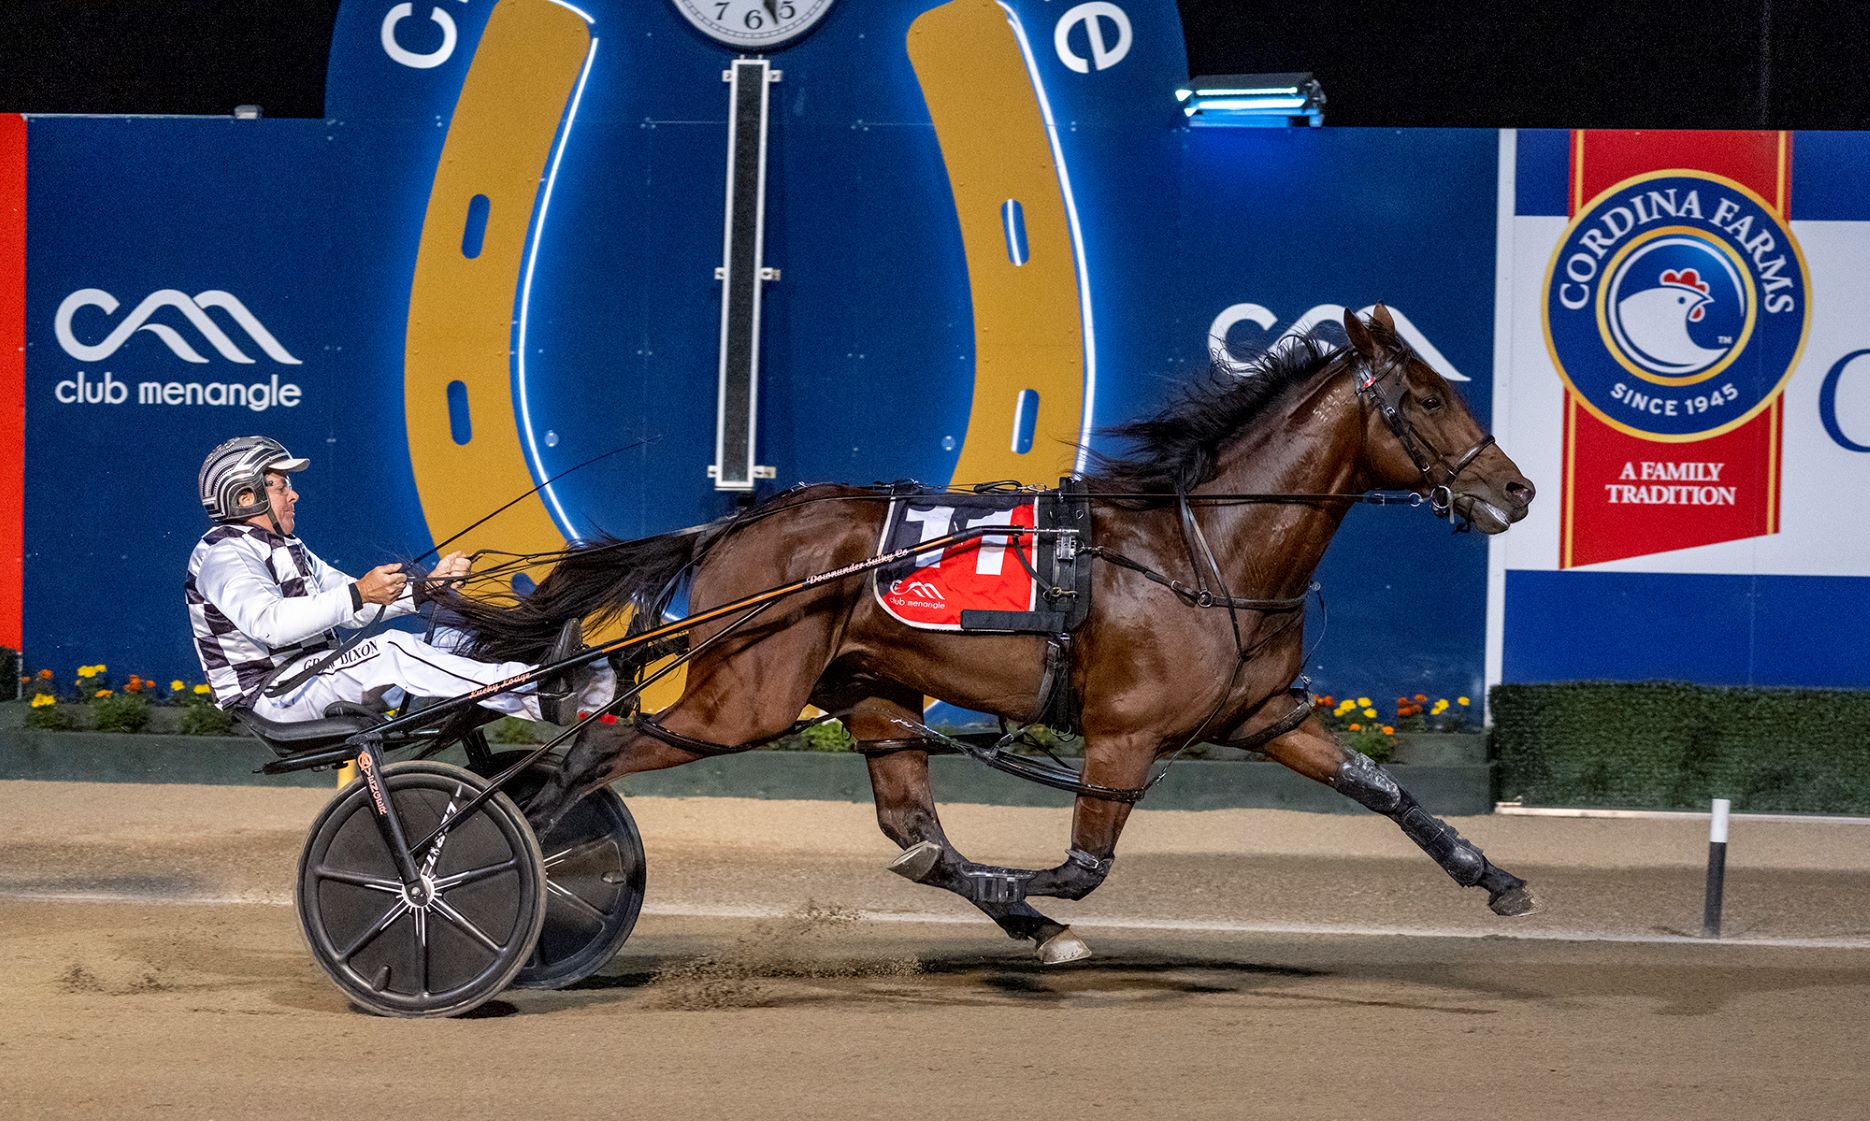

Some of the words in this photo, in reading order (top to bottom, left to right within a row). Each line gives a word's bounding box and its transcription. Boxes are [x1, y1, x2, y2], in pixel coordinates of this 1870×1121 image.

[714, 2, 730, 20] 7
[744, 9, 764, 30] 6
[778, 1, 796, 19] 5
[1558, 188, 1704, 311] CORDINA
[1709, 198, 1795, 315] FARMS
[55, 371, 129, 405] club
[138, 374, 302, 412] menangle
[1610, 382, 1678, 416] SINCE
[1684, 383, 1739, 415] 1945
[1619, 461, 1638, 481] A
[1640, 461, 1725, 482] FAMILY
[1604, 484, 1737, 506] TRADITION
[906, 505, 1013, 576] 11
[890, 596, 906, 606] club
[907, 600, 946, 610] menangle
[340, 640, 378, 665] DIXON
[469, 683, 501, 699] Lucky
[501, 672, 530, 688] Lodge
[358, 751, 388, 816] AVENGER
